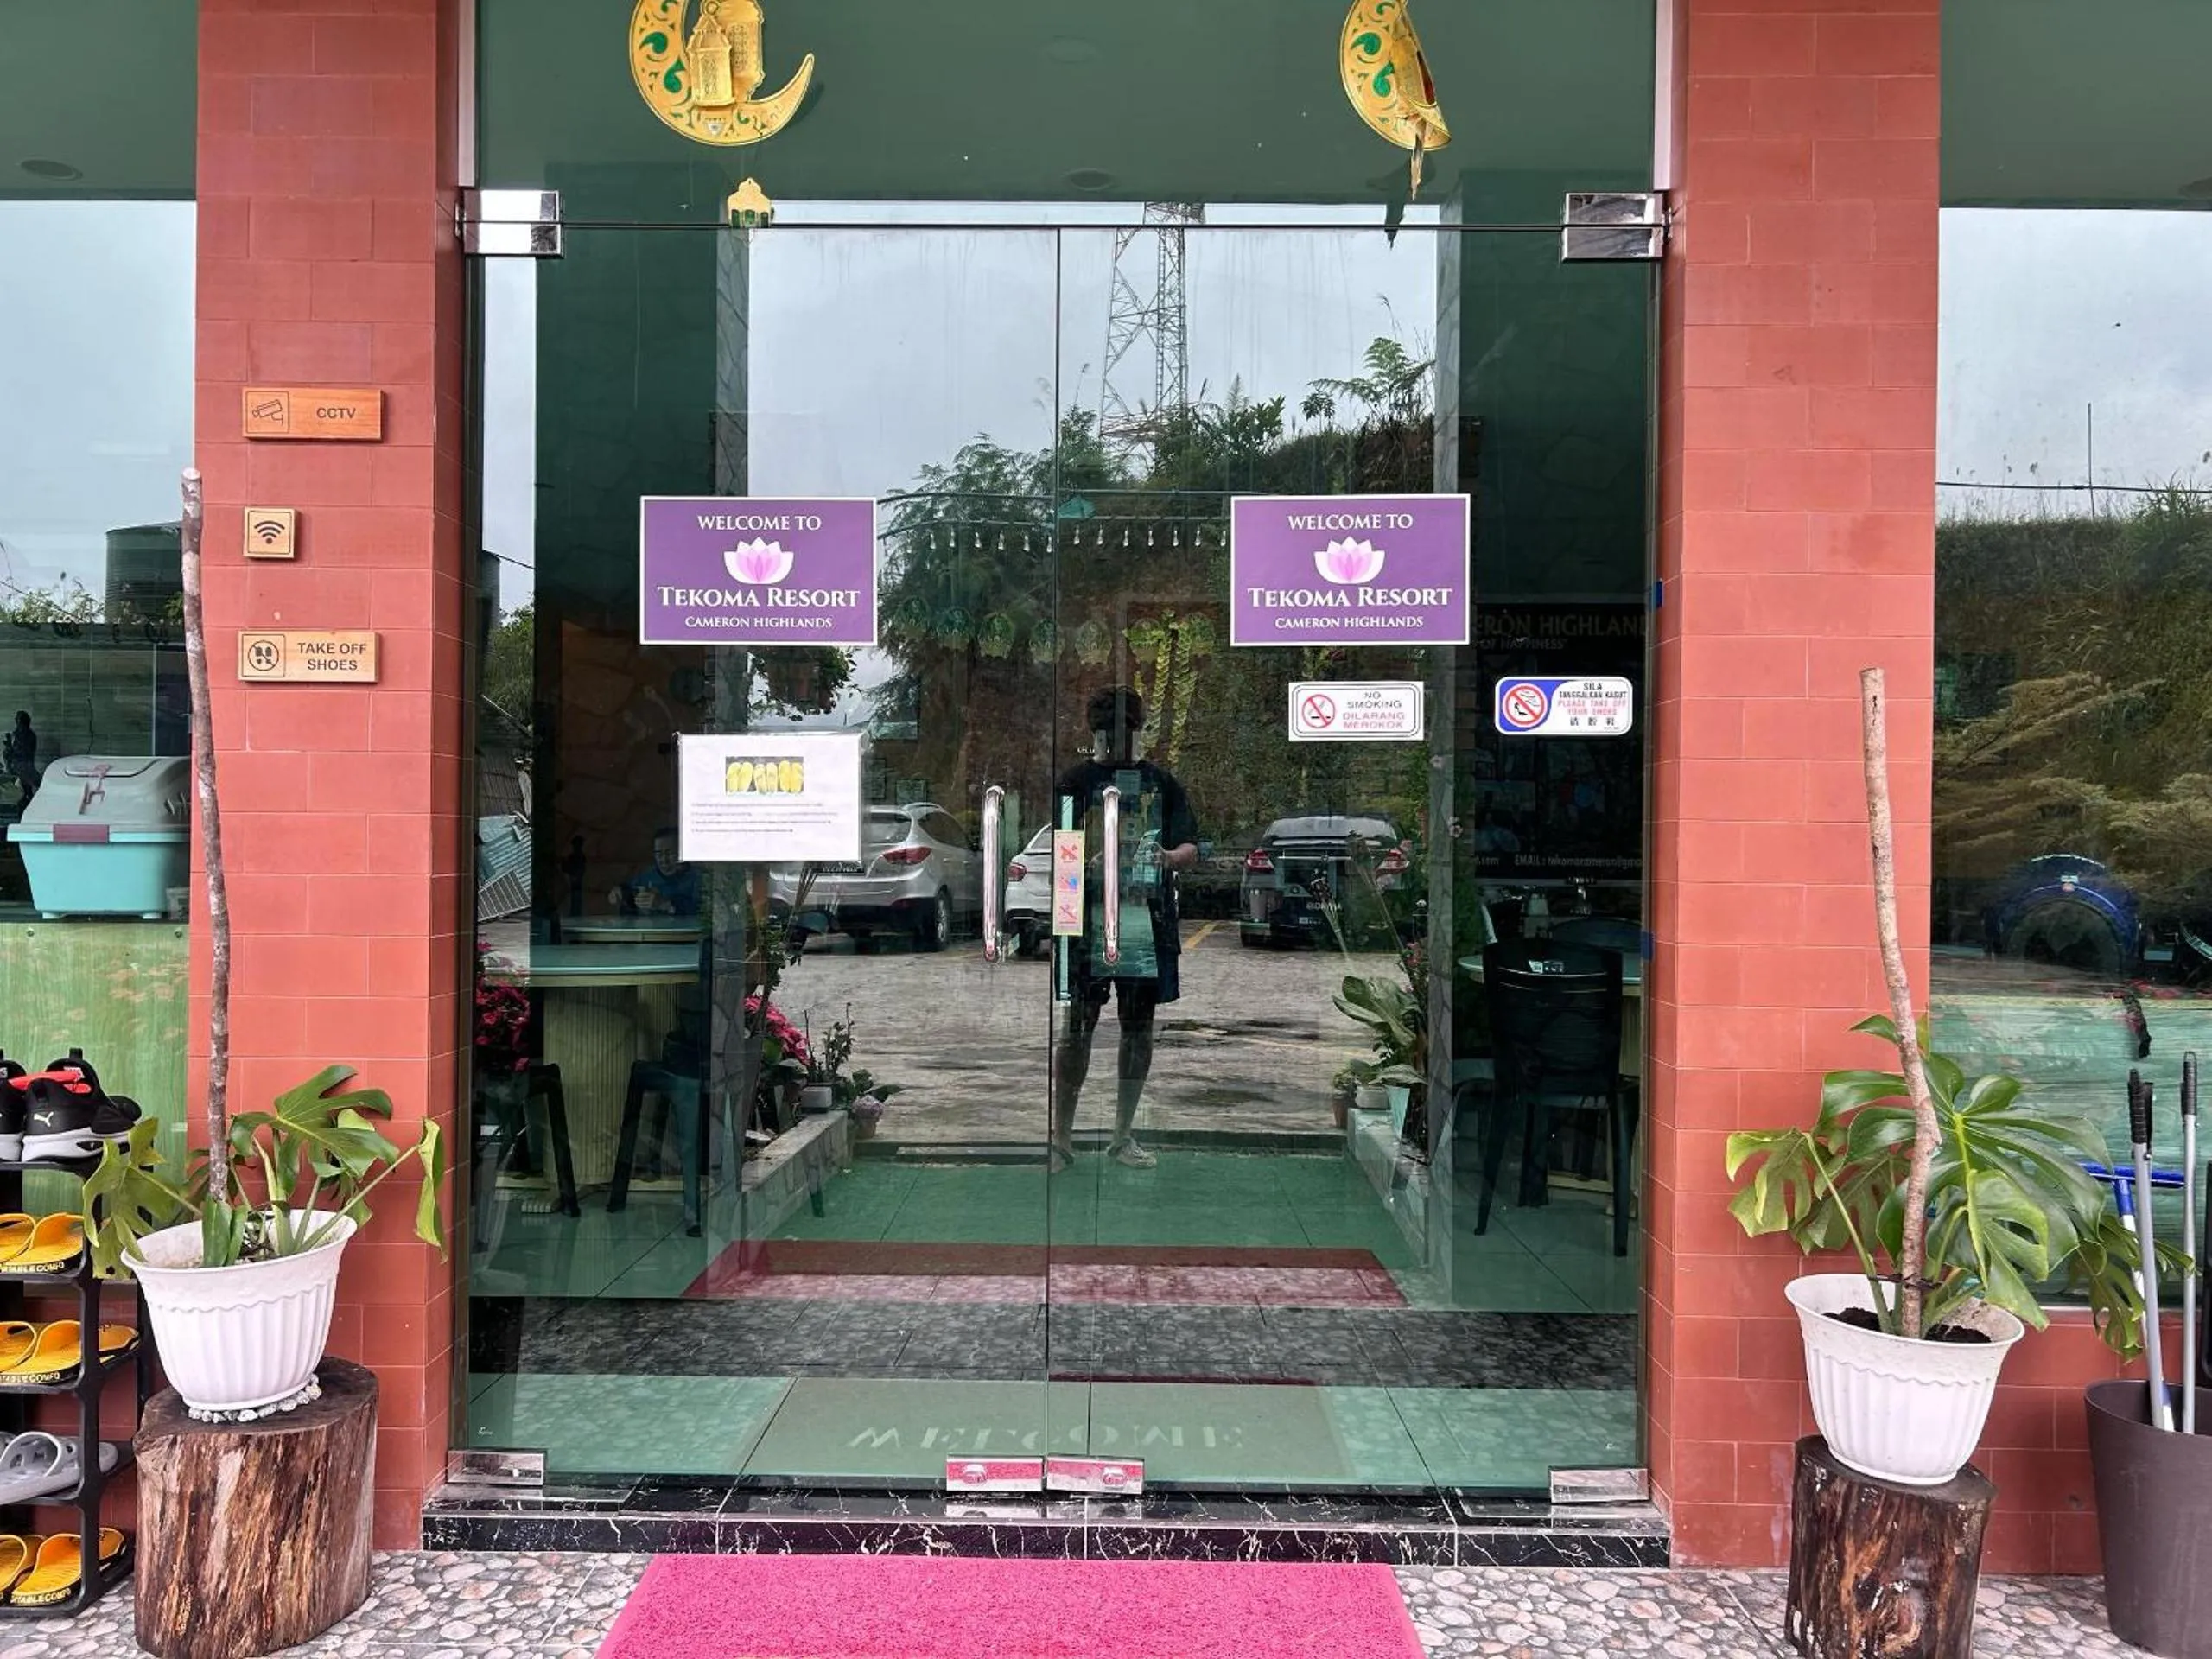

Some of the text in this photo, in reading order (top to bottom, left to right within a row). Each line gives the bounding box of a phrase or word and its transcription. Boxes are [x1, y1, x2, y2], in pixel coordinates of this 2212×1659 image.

[316, 407, 356, 419] CCTV
[698, 515, 821, 531] WELCOME TO
[1287, 513, 1414, 530] WELCOME TO
[657, 586, 860, 607] TEKOMA RESORT
[1247, 586, 1452, 607] TEKOMA RESORT
[684, 615, 832, 628] CAMERON HIGHLANDS
[1274, 615, 1424, 629] CAMERON HIGHLANDS
[297, 643, 367, 655] TAKE OFF
[308, 659, 358, 671] SHOES
[1583, 682, 1603, 690] SILA
[1363, 690, 1381, 699] NO
[1346, 700, 1402, 709] SMOKING
[1342, 712, 1405, 721] DILARANG
[1344, 721, 1404, 729] MEROKOK
